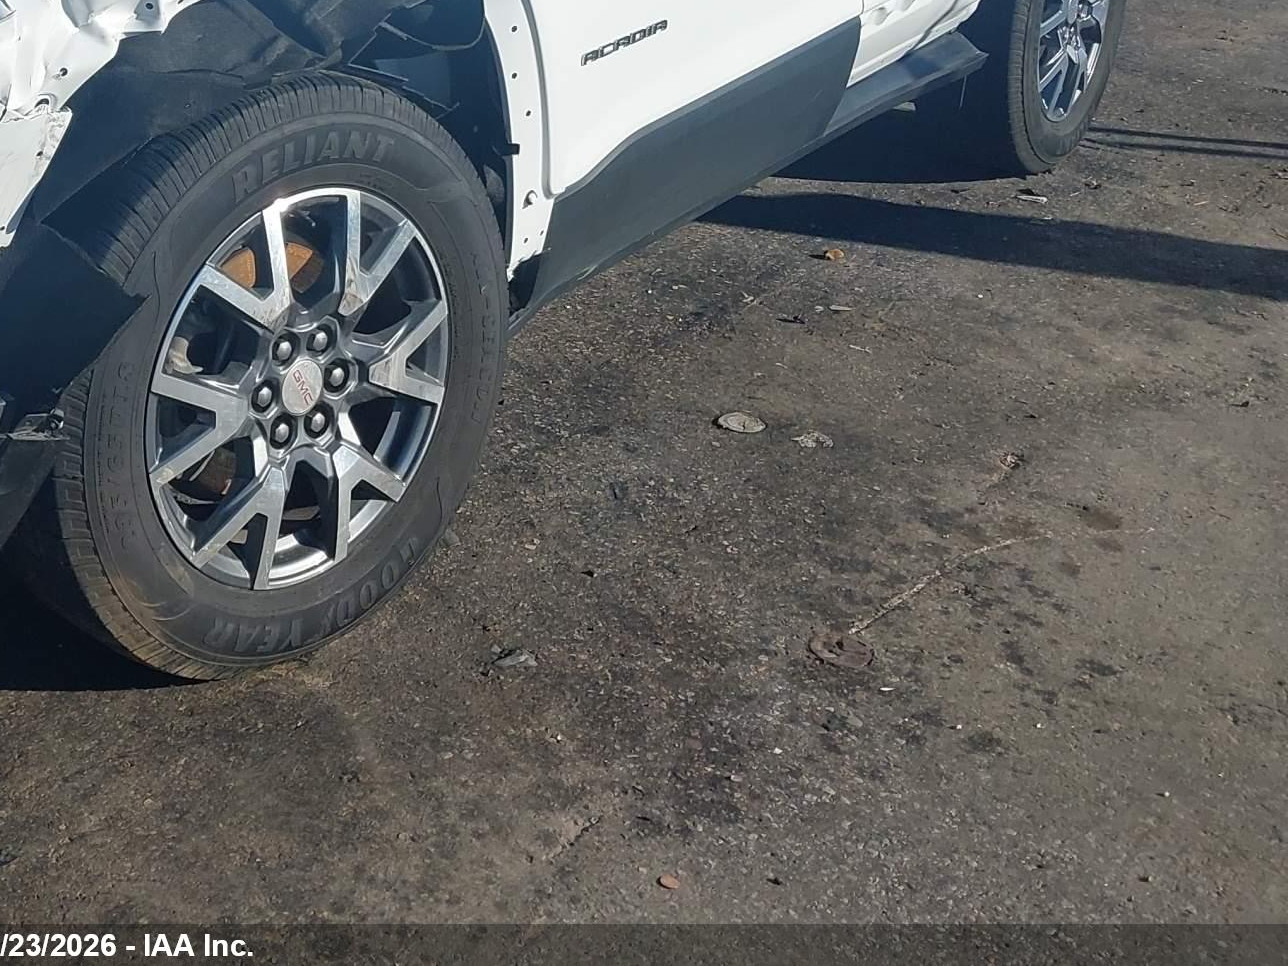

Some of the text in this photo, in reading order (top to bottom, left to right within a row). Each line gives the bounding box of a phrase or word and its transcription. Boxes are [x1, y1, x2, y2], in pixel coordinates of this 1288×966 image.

[580, 19, 668, 66] ACADIA
[231, 129, 395, 204] RELIANT
[292, 369, 314, 406] GMC
